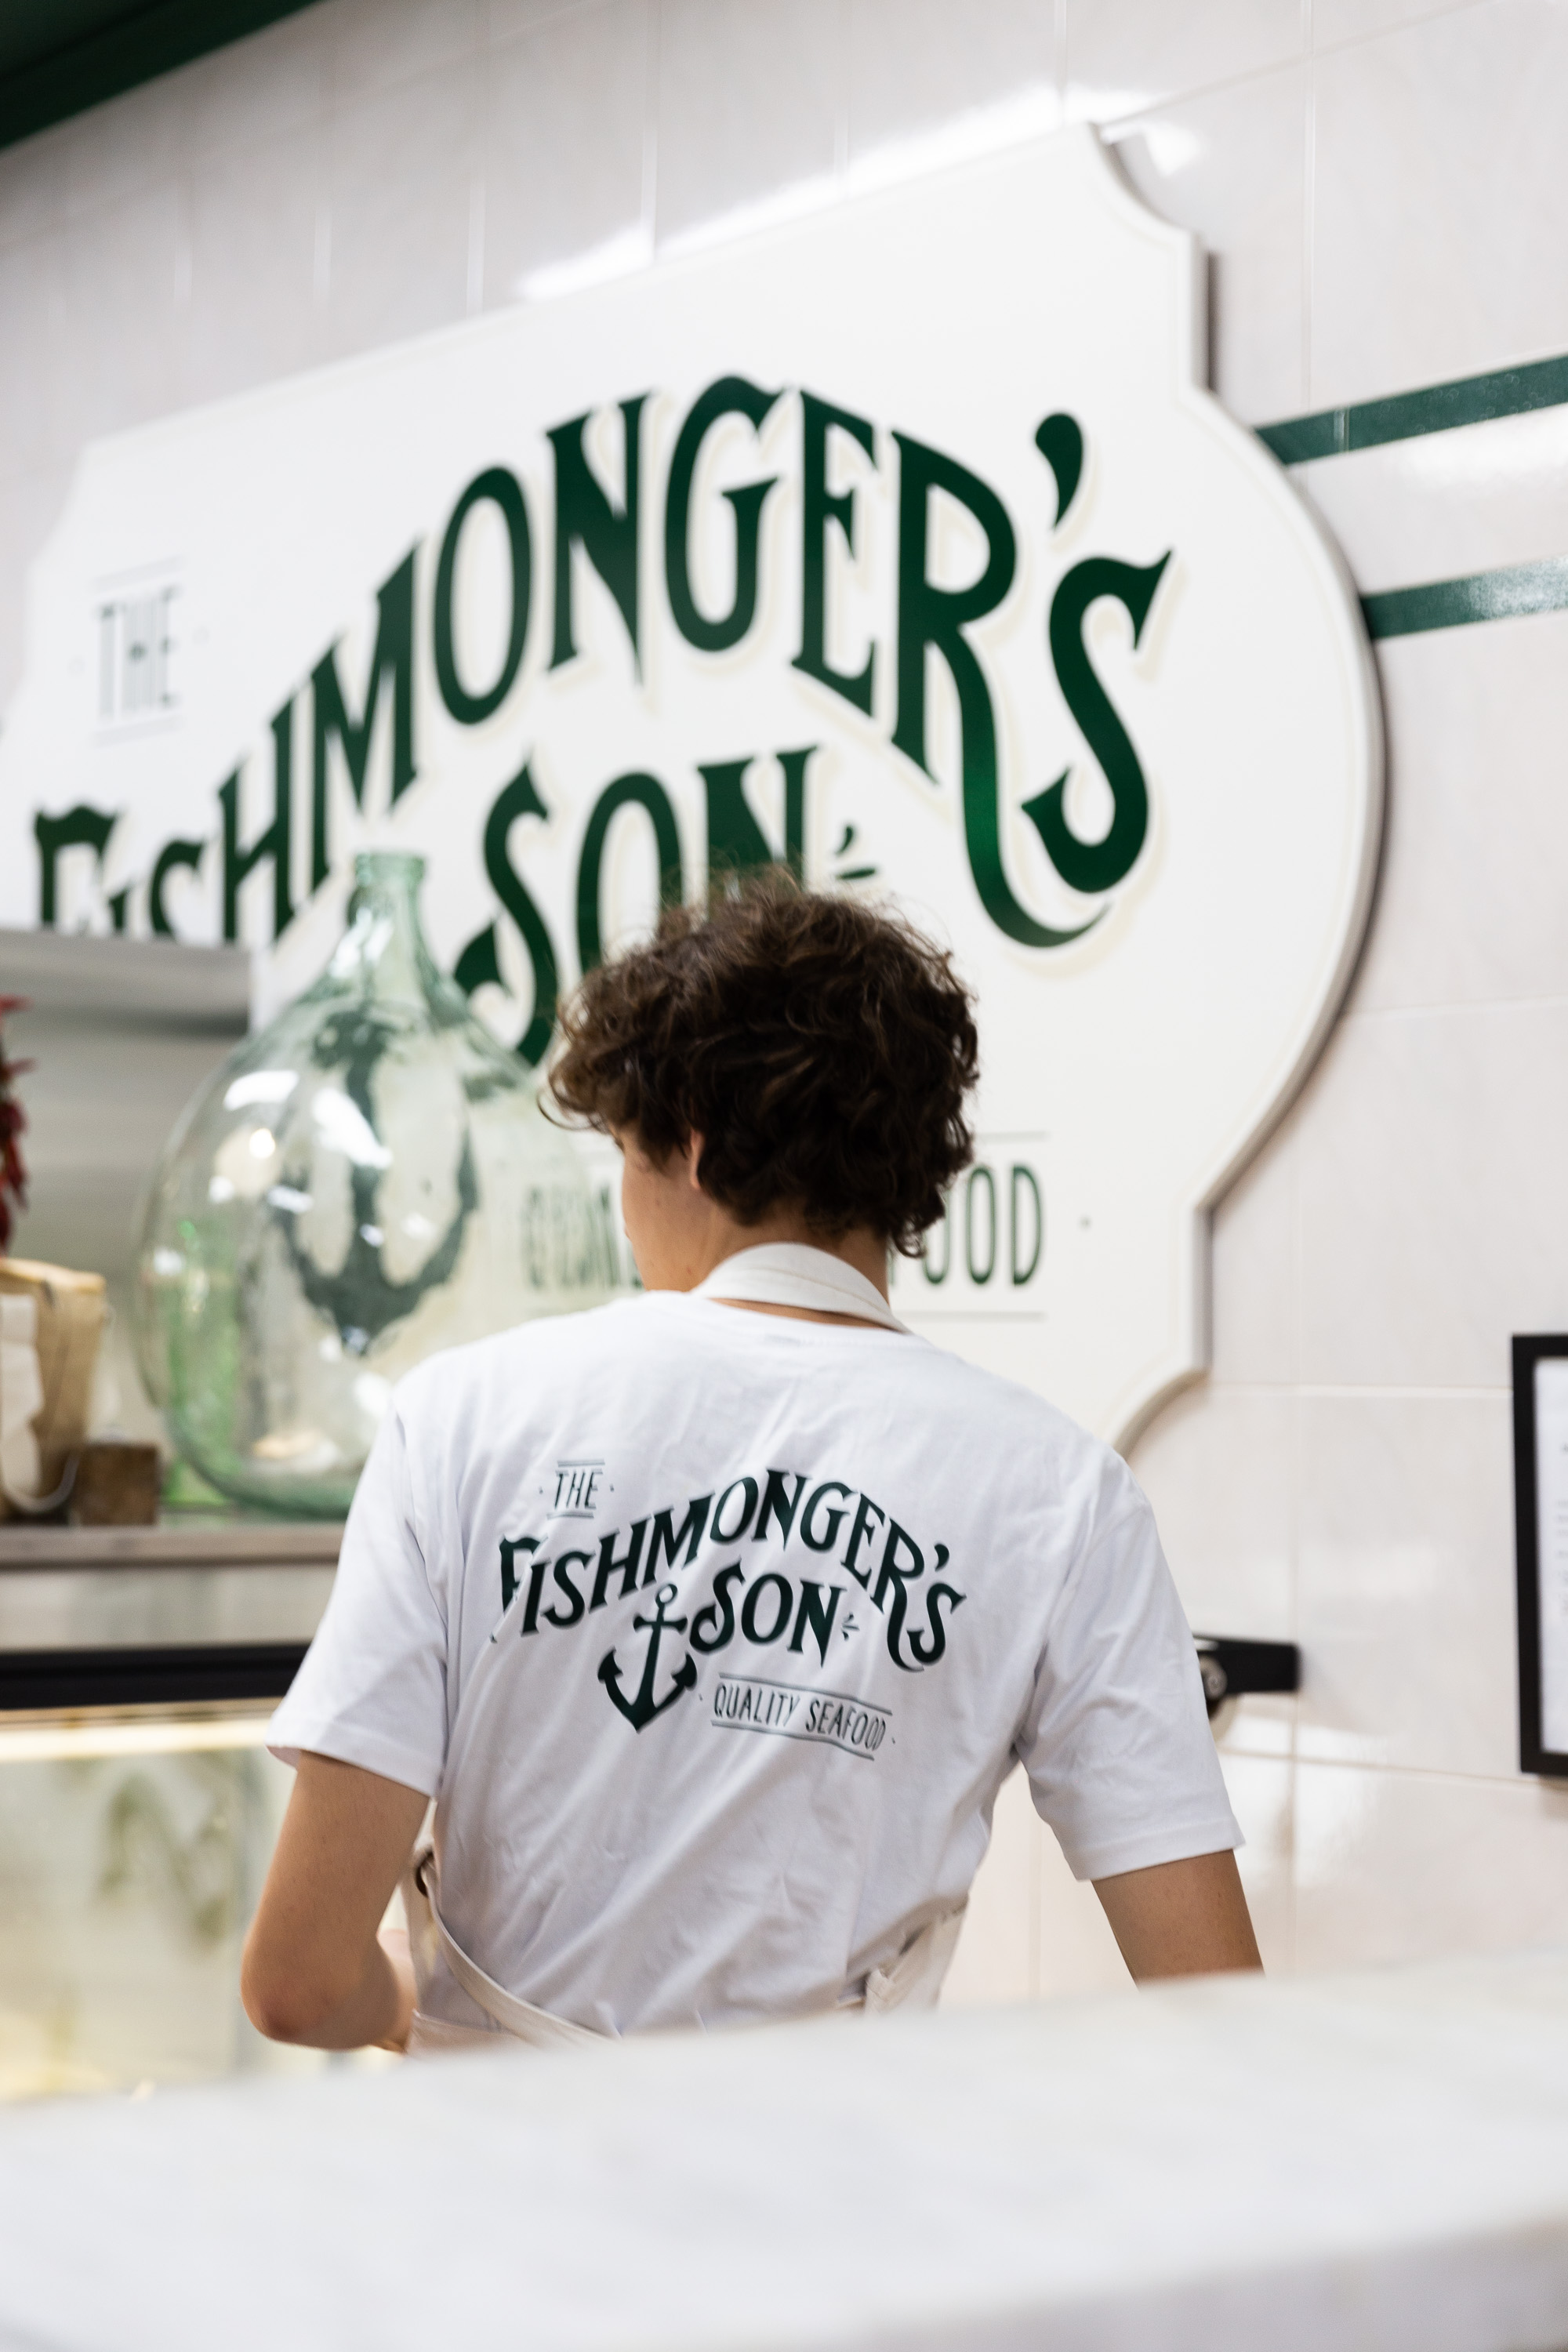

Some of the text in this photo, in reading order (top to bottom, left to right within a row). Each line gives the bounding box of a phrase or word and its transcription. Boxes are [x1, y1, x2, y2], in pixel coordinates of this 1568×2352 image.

[34, 374, 1173, 949] FSHMONGER'S
[96, 583, 182, 723] THE
[554, 1468, 604, 1510] THE
[490, 1468, 967, 1673] FISHMONGER'S
[689, 1559, 848, 1668] SON
[713, 1682, 887, 1752] QUALITY SEAFOOD
